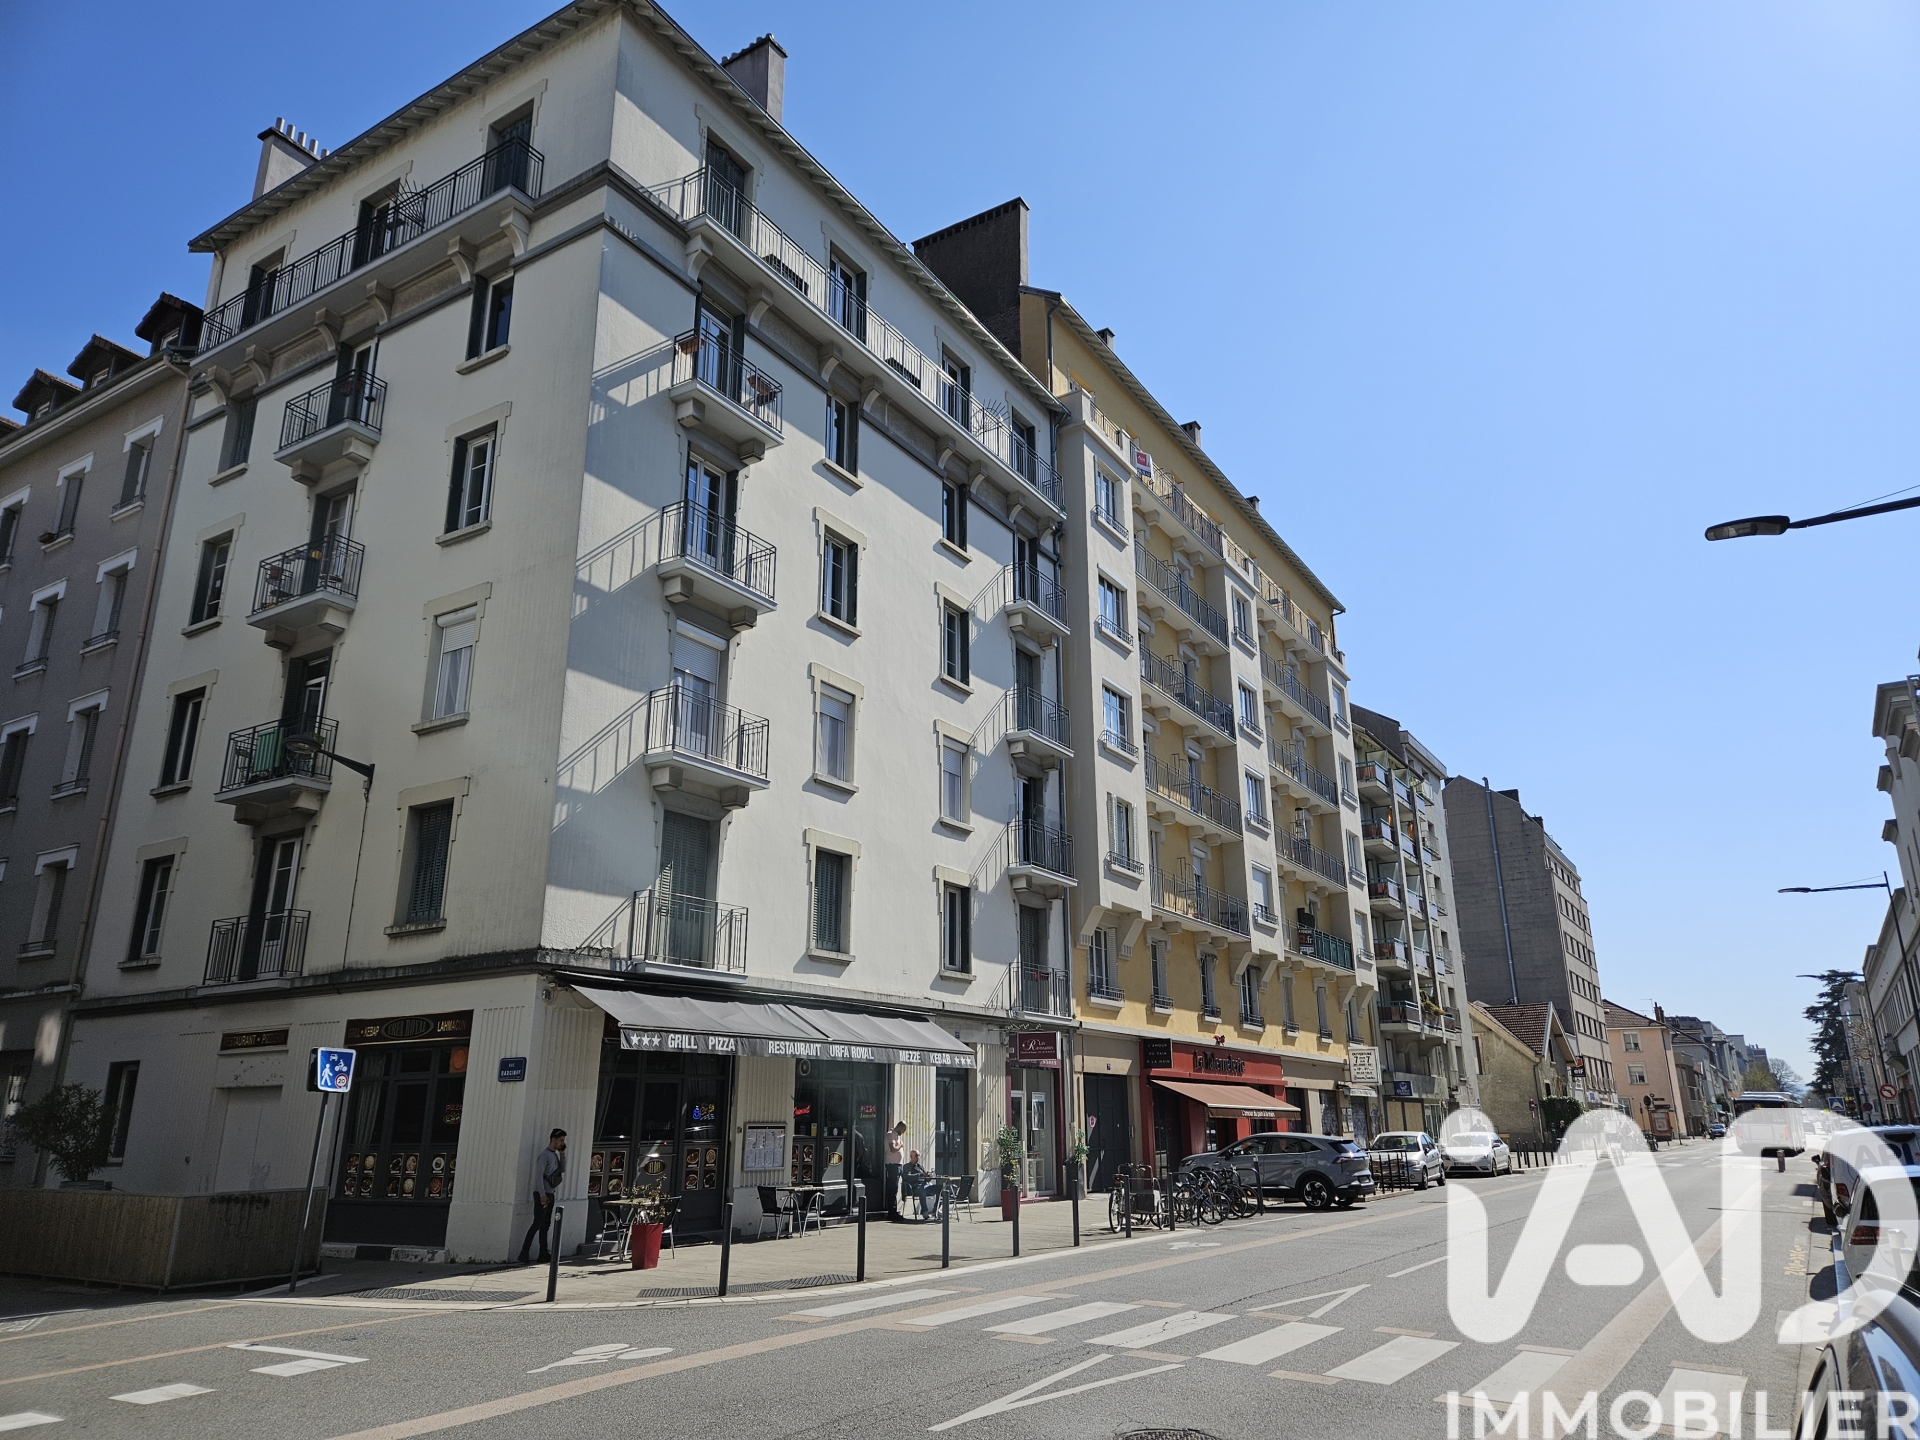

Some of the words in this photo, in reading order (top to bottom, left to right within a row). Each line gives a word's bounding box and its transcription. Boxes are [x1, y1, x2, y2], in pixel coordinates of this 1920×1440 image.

[363, 1026, 380, 1038] KEBAP
[404, 1019, 427, 1037] ROYAL
[436, 1019, 467, 1033] LAHMACUN
[224, 1034, 257, 1048] RESTAURANT
[667, 1034, 698, 1050] GRILL
[708, 1036, 737, 1052] PIZZA
[768, 1041, 822, 1056] RESTAURANT
[829, 1044, 850, 1058] URFA
[851, 1045, 875, 1060] ROYAL
[929, 1052, 952, 1065] KEBAB
[1193, 1050, 1204, 1070] La
